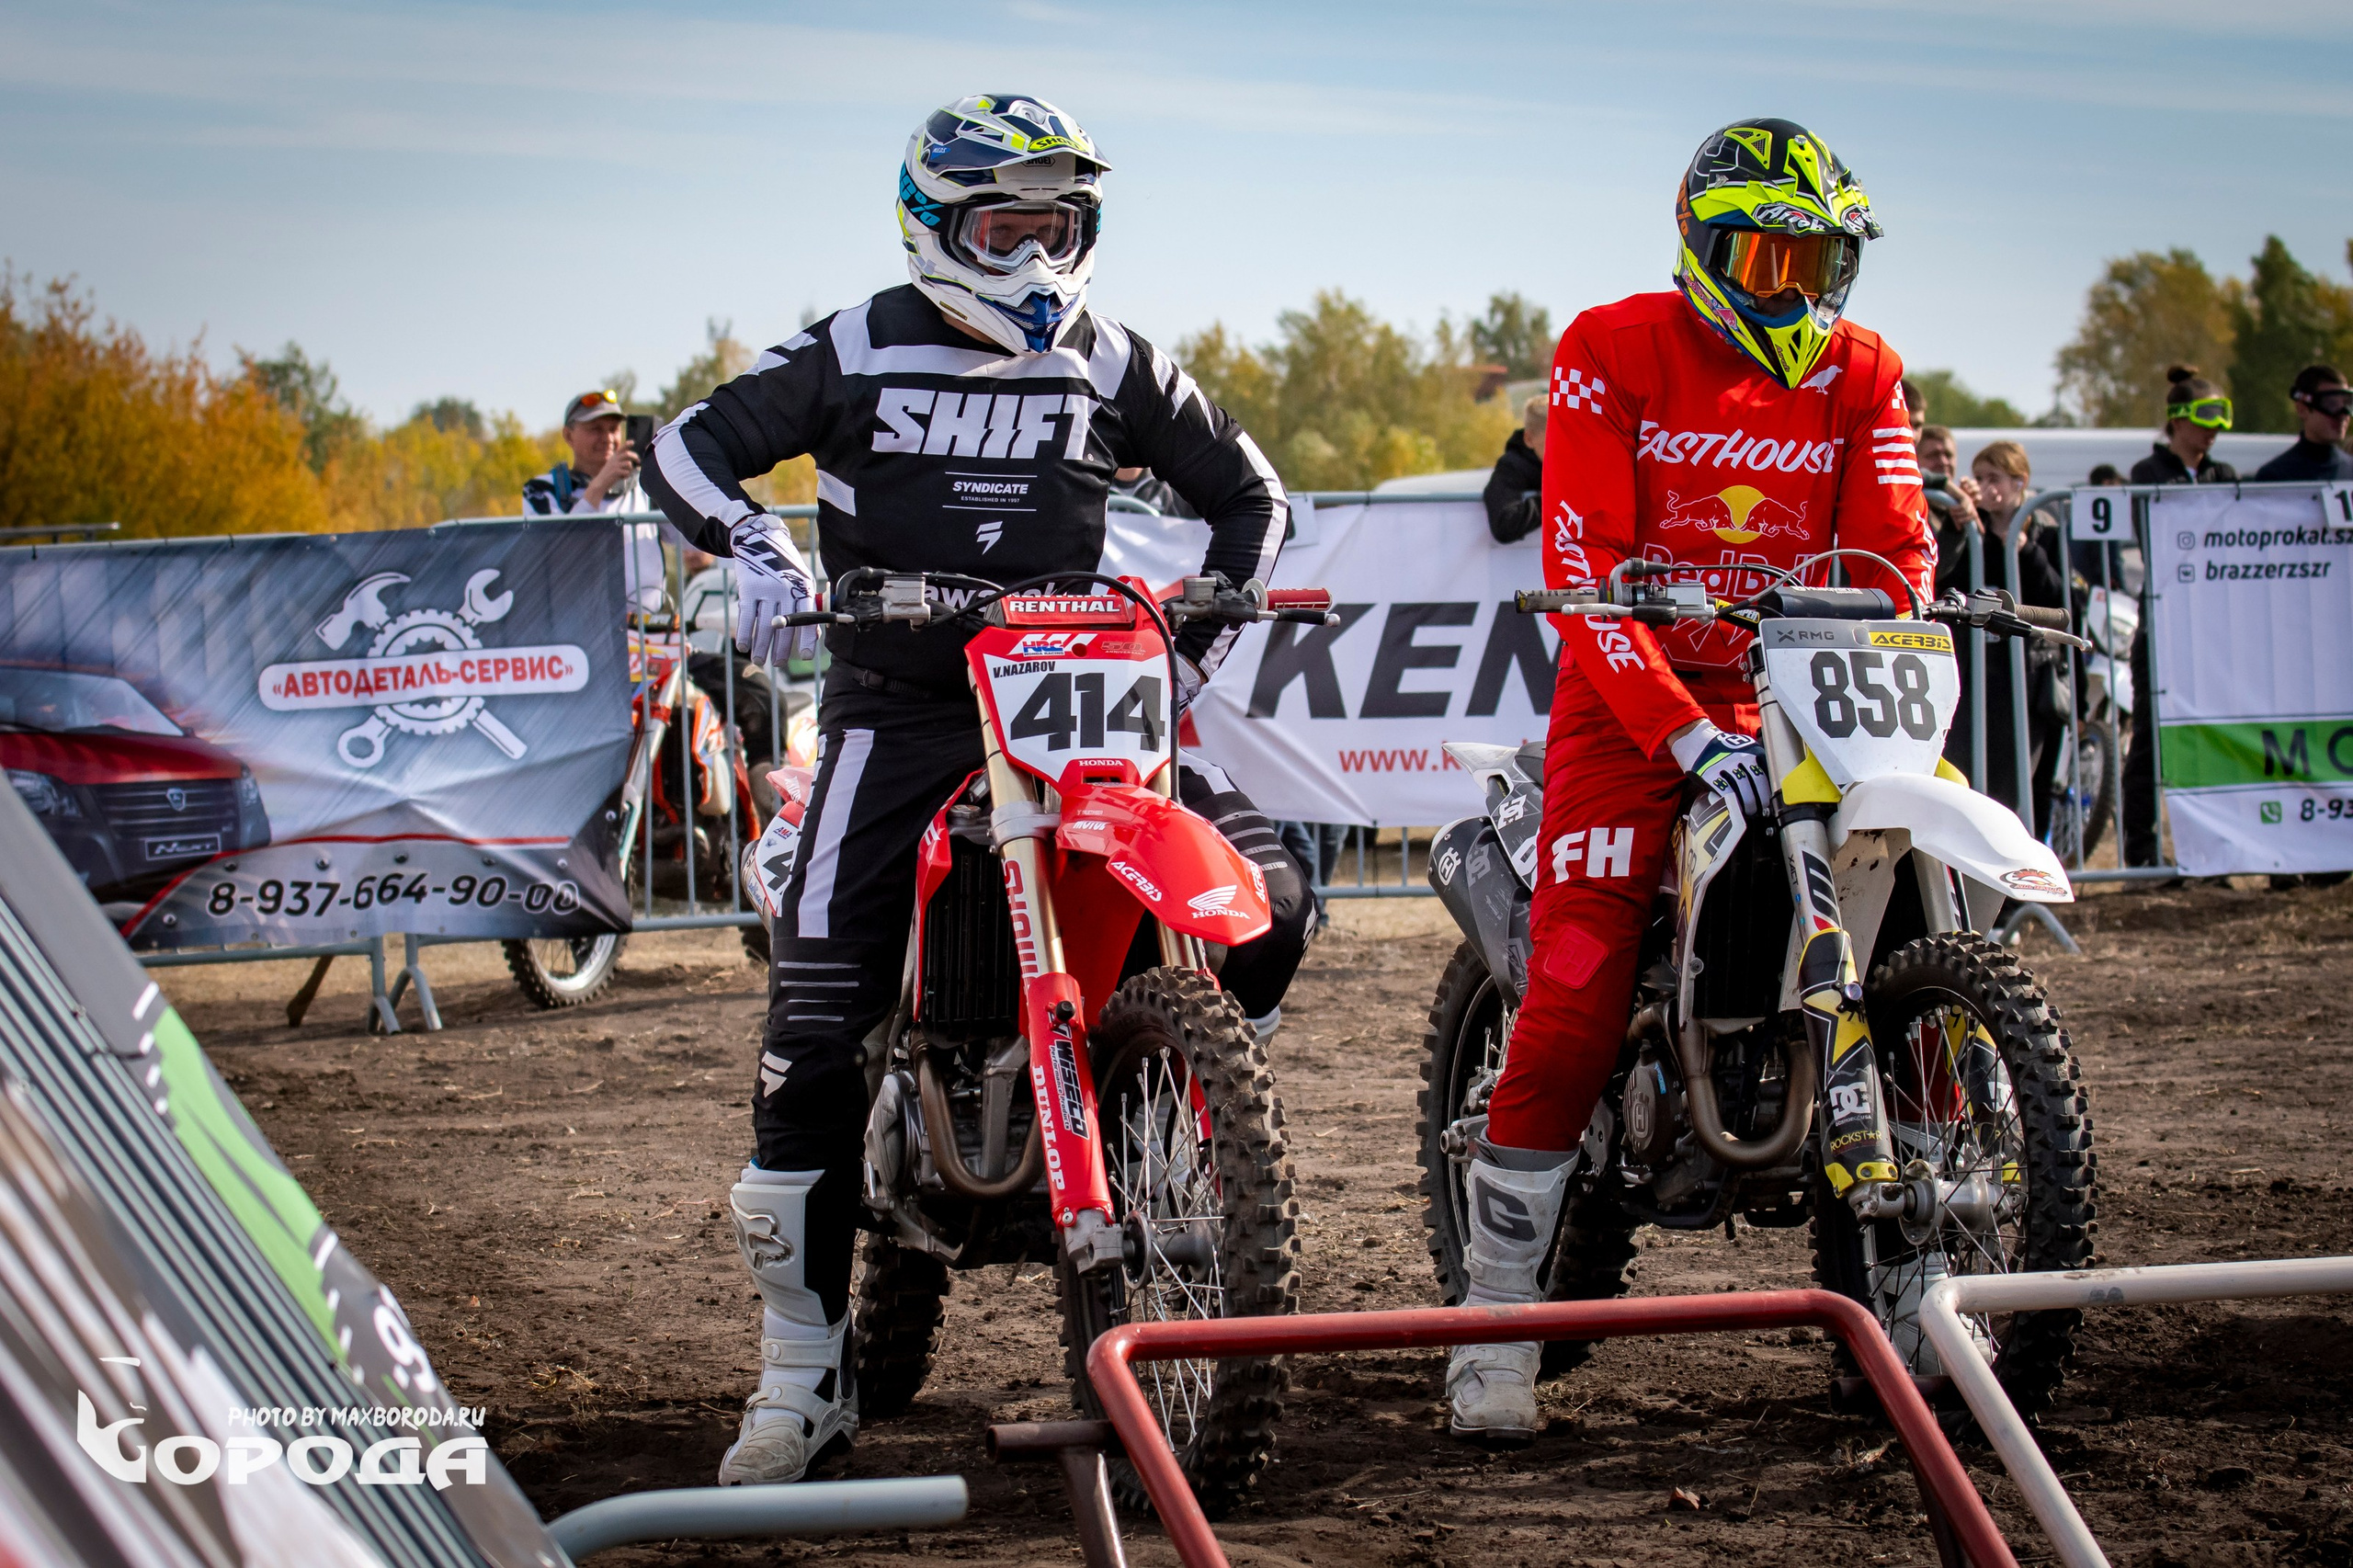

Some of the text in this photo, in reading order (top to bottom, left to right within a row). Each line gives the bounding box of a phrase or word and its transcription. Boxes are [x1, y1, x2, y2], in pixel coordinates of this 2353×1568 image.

[871, 388, 1100, 460] SHIFT
[952, 481, 1029, 495] SYNDICATE
[961, 495, 998, 504] ESTABLISHED
[2092, 497, 2112, 534] 9
[2206, 560, 2332, 581] brazzerzszr
[1008, 600, 1120, 613] RENTHAL
[1022, 640, 1063, 653] HRC
[1798, 631, 1835, 642] RMG
[272, 653, 574, 700] «АВТОДЕТАЛЬ-СЕРВИС»
[993, 661, 1056, 678] V.NAZAROV
[1010, 673, 1165, 752] 414
[1810, 652, 1937, 741] 858
[1552, 827, 1635, 884] FH
[1788, 854, 1800, 886] XACT
[1110, 861, 1163, 903] ACERBIS
[1191, 909, 1251, 920] HONDA
[1032, 1064, 1066, 1191] DUNLOP
